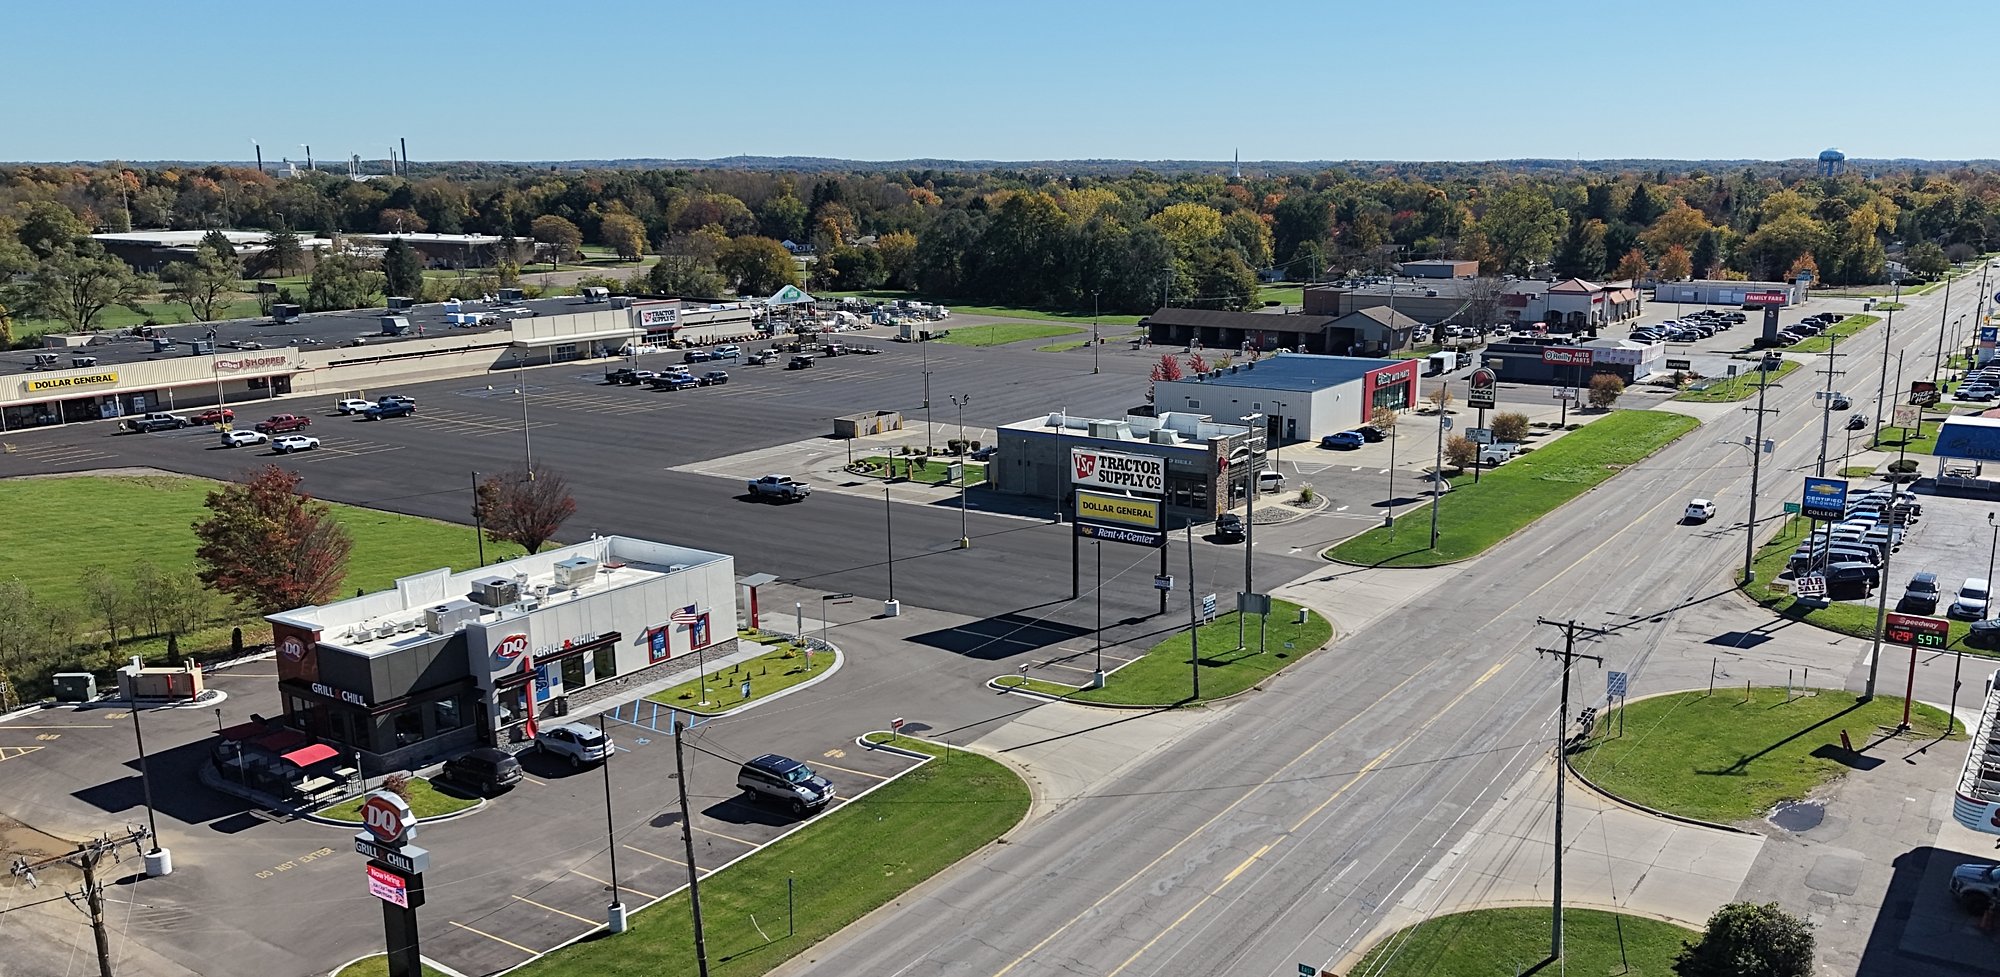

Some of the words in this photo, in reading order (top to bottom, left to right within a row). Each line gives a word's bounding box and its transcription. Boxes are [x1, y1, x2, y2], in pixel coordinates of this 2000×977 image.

[34, 378, 72, 390] DOLLAR
[73, 374, 114, 386] GENERAL
[1075, 454, 1093, 476] TSC
[1099, 456, 1160, 475] TRACTOR
[1099, 470, 1144, 487] SUPPLY
[1082, 501, 1114, 513] DOLLAR
[1116, 506, 1153, 518] GENERAL
[1807, 509, 1838, 517] COLLEGE
[1797, 577, 1823, 586] CAR
[1798, 584, 1825, 592] SALE
[1899, 617, 1939, 629] Speedway
[284, 641, 300, 658] DQ
[502, 638, 525, 655] DQ
[535, 642, 563, 657] GRILL
[572, 632, 600, 646] CHILL
[311, 682, 335, 698] GRILL
[341, 690, 365, 706] CHILL
[367, 805, 396, 836] DQ
[255, 870, 274, 879] DO
[274, 861, 298, 872] NOT
[299, 847, 335, 863] ENTER
[355, 841, 379, 859] GRILL
[387, 853, 412, 871] CHILL
